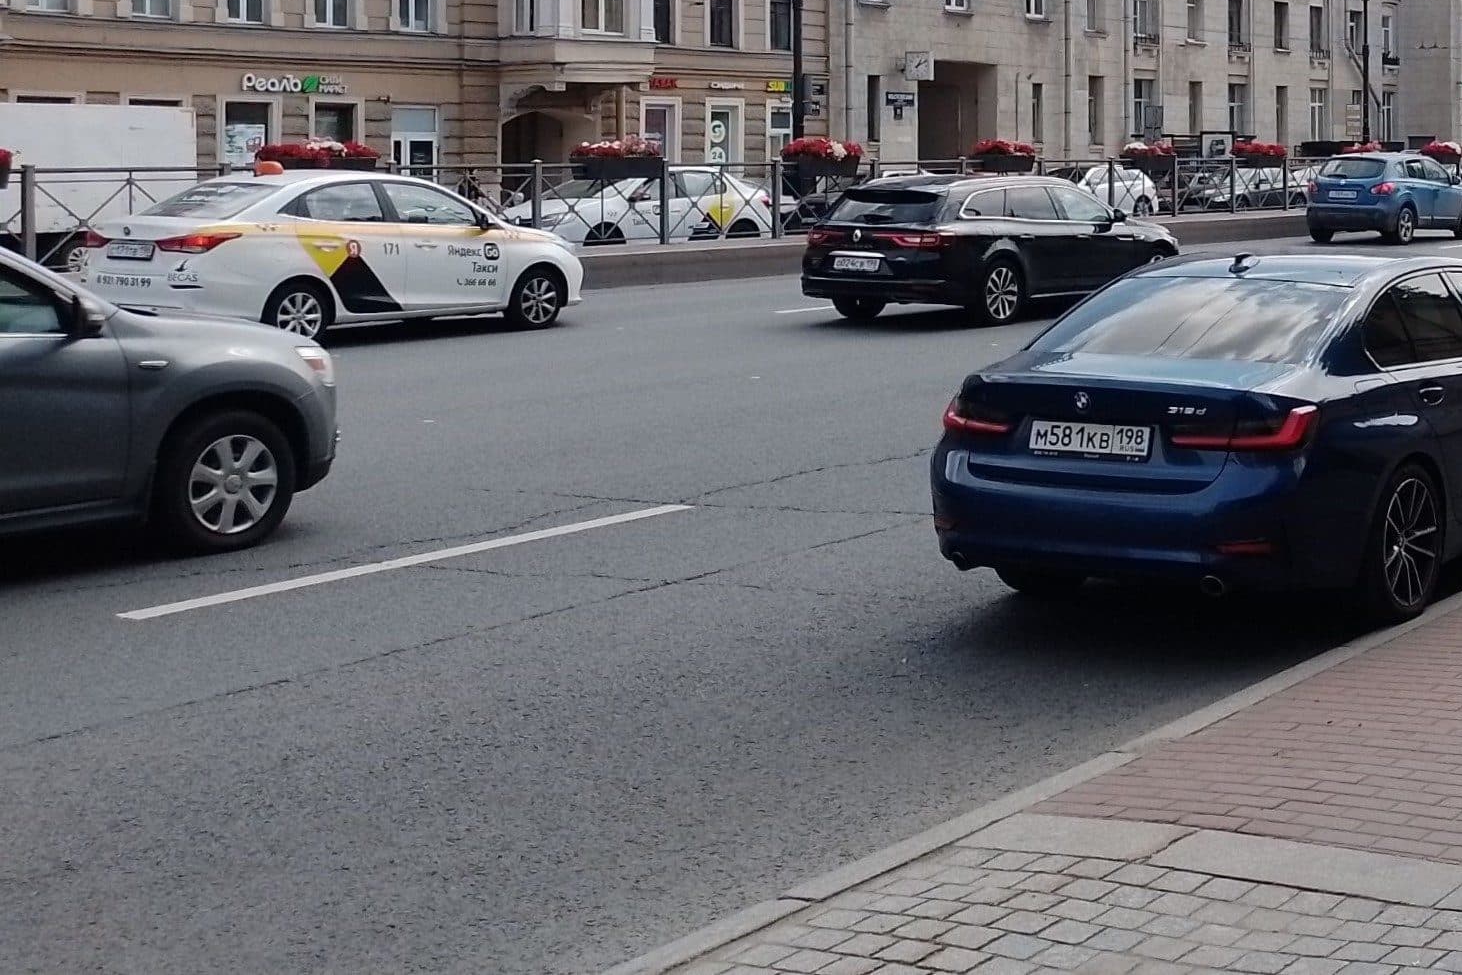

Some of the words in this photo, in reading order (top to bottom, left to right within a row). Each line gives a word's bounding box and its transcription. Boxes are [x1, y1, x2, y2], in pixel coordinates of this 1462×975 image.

[383, 243, 400, 255] 171
[448, 245, 482, 257] Яндекс
[471, 262, 498, 274] Такси
[1116, 428, 1144, 445] 198
